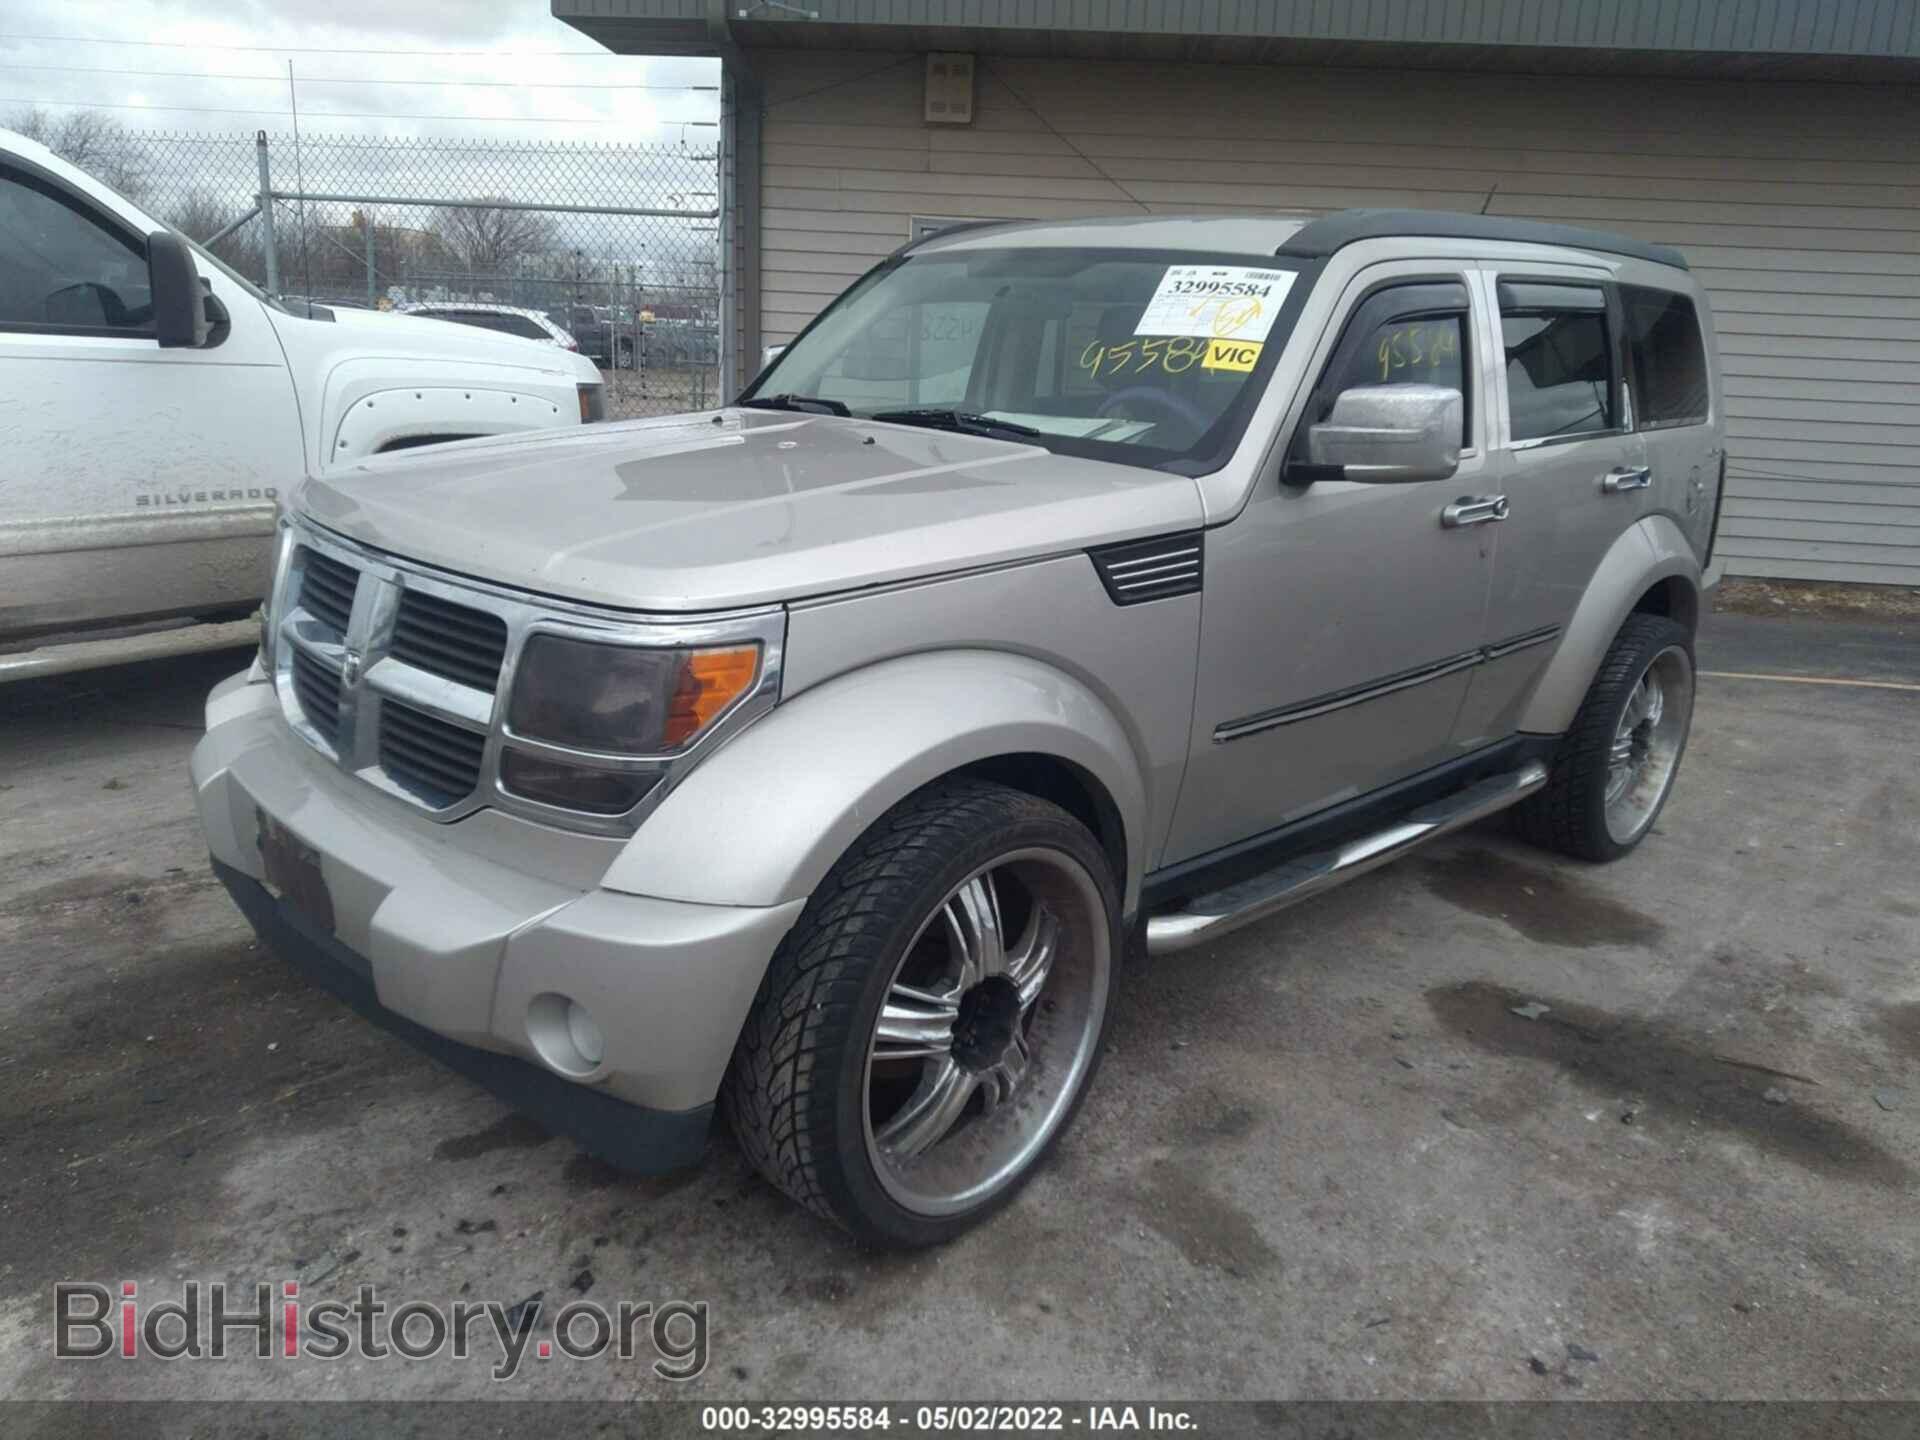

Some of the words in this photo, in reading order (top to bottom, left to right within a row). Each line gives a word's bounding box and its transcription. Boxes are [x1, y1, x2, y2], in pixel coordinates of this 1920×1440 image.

[1168, 279, 1272, 298] 32995584
[1213, 345, 1257, 365] VIC
[136, 487, 278, 506] SILVERADO
